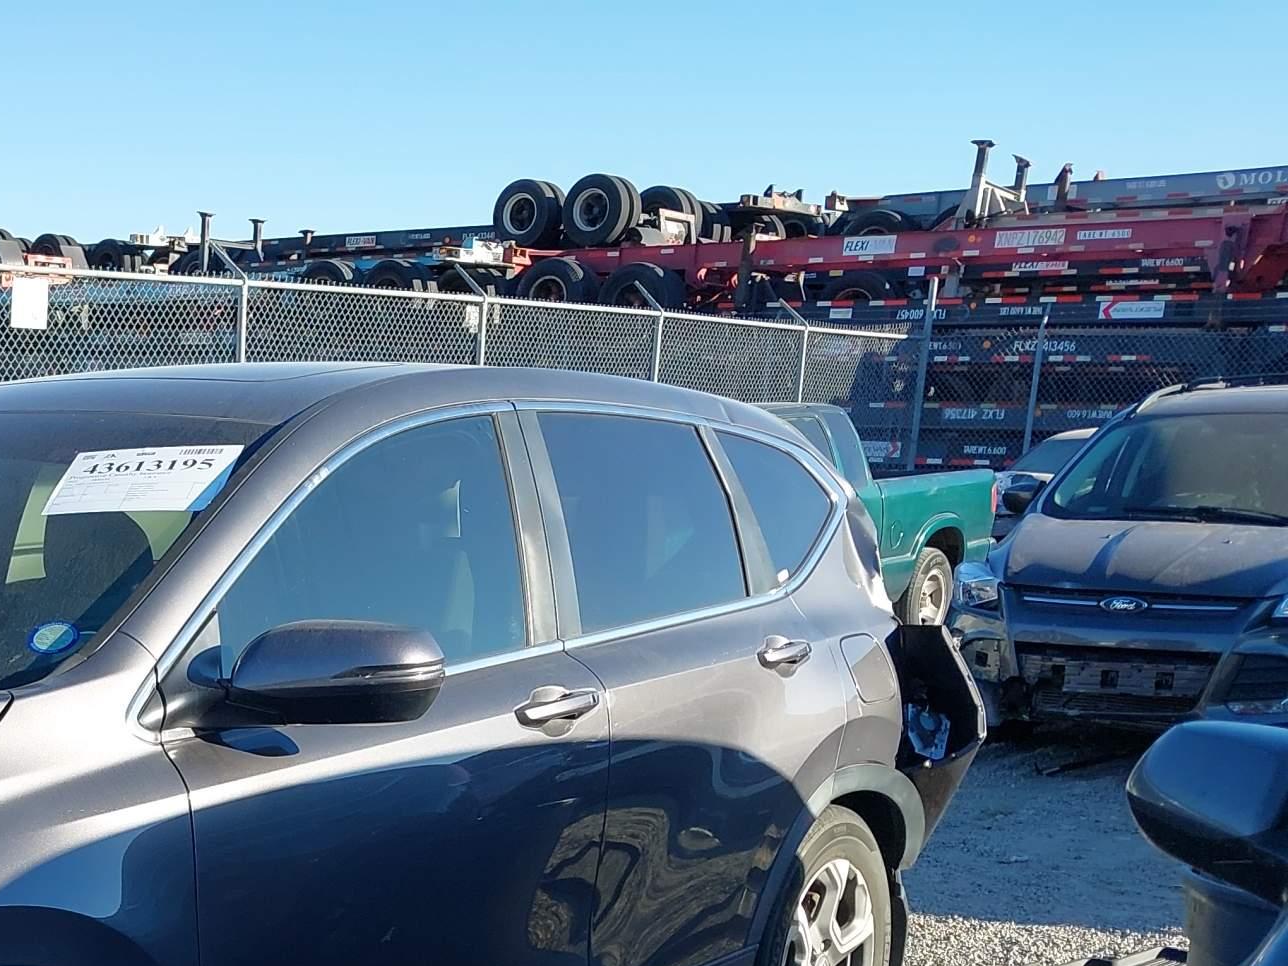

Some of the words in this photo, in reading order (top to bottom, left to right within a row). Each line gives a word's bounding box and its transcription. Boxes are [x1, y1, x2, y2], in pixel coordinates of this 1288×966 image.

[1239, 170, 1288, 186] MOL
[83, 458, 216, 475] 43613195
[1109, 599, 1137, 610] Ford
